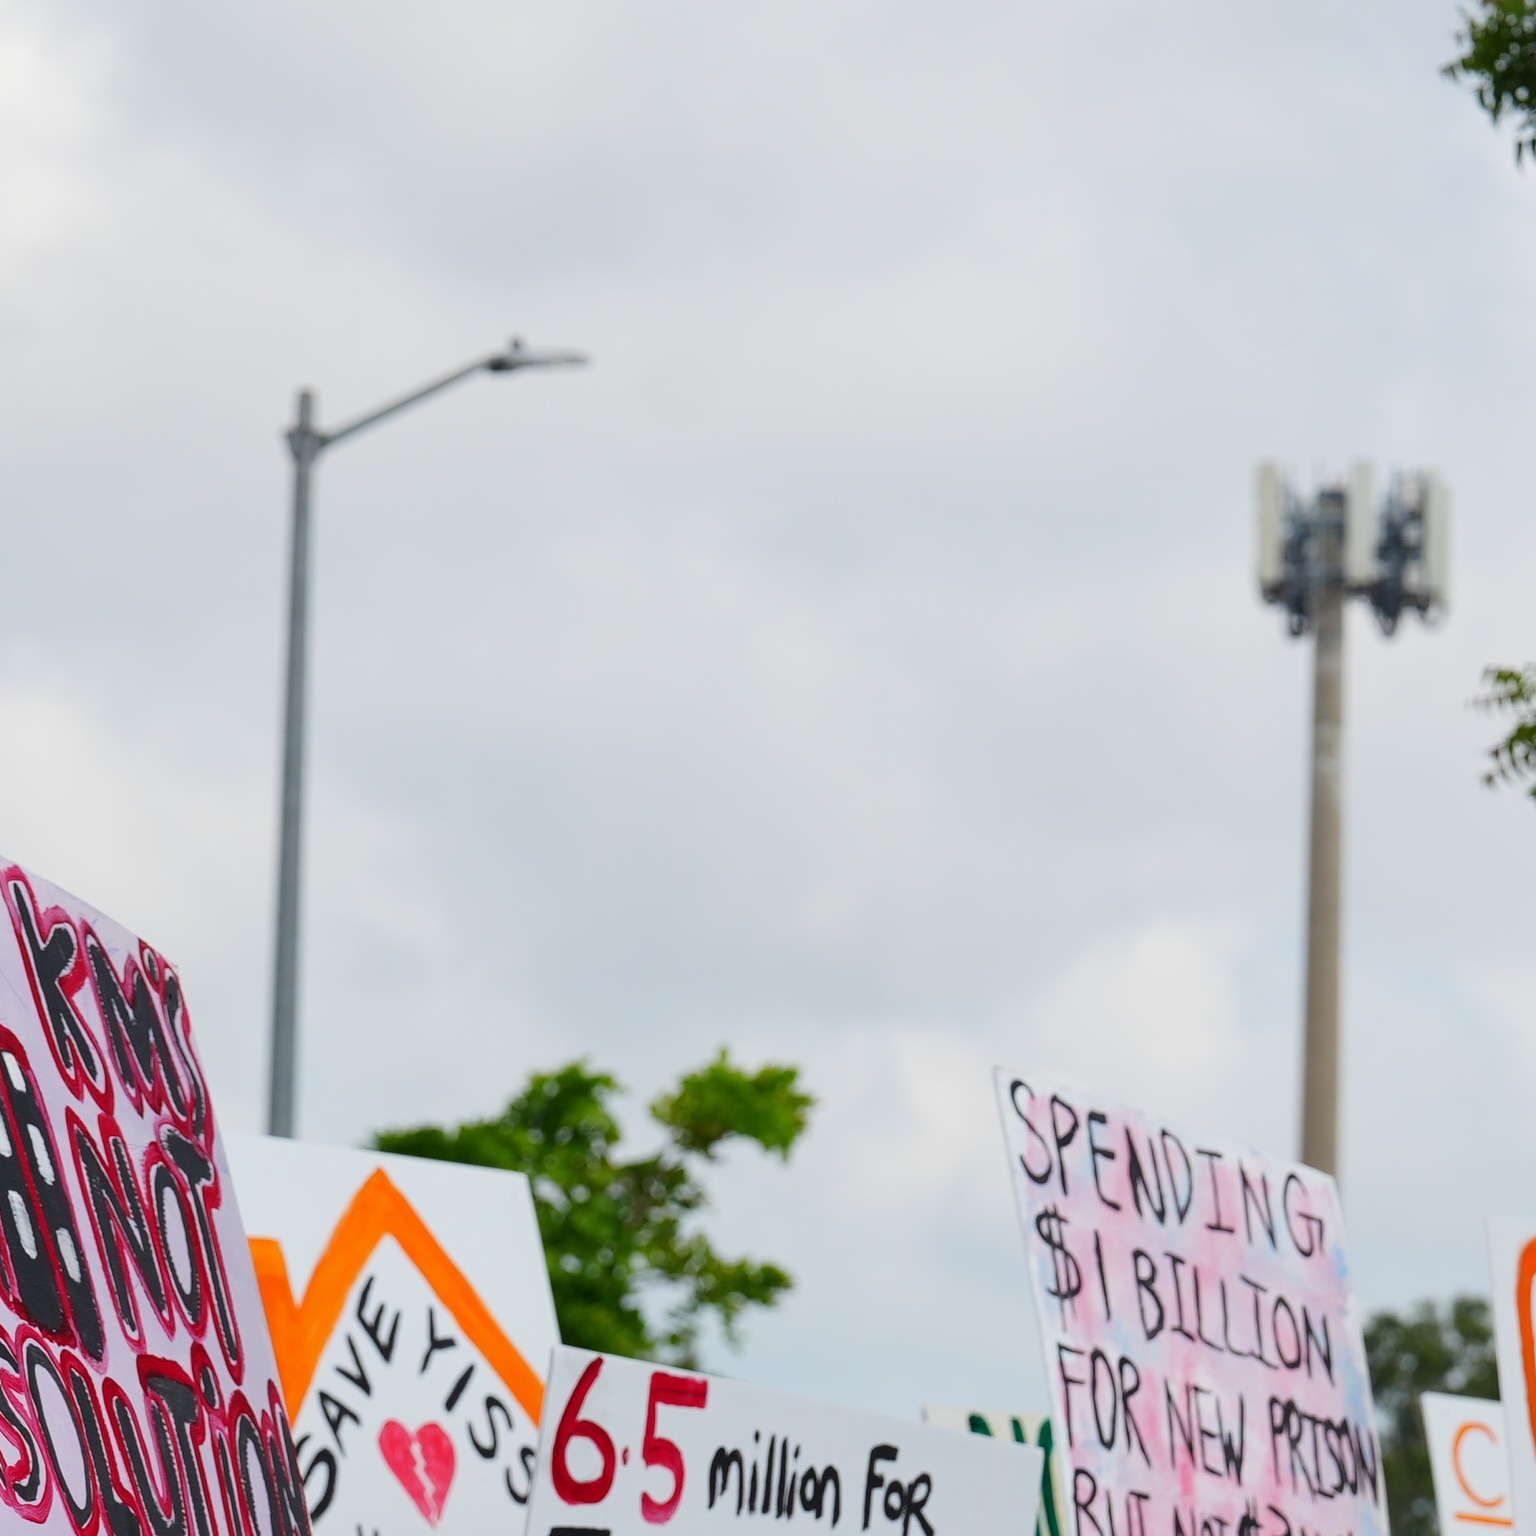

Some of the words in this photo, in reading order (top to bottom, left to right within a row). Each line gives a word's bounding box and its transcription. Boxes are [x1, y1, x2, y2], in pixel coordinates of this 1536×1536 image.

[65, 1107, 244, 1387] NOT
[1007, 1077, 1325, 1259] SPENDING
[1033, 1205, 1112, 1323] $1
[1134, 1249, 1335, 1386] BILLION
[293, 1275, 401, 1522] SAVE
[421, 1306, 536, 1506] YISS
[551, 1355, 708, 1525] 6.5
[1058, 1343, 1153, 1470] FOR
[1166, 1372, 1245, 1486] NEW
[1269, 1395, 1380, 1507] PRISON
